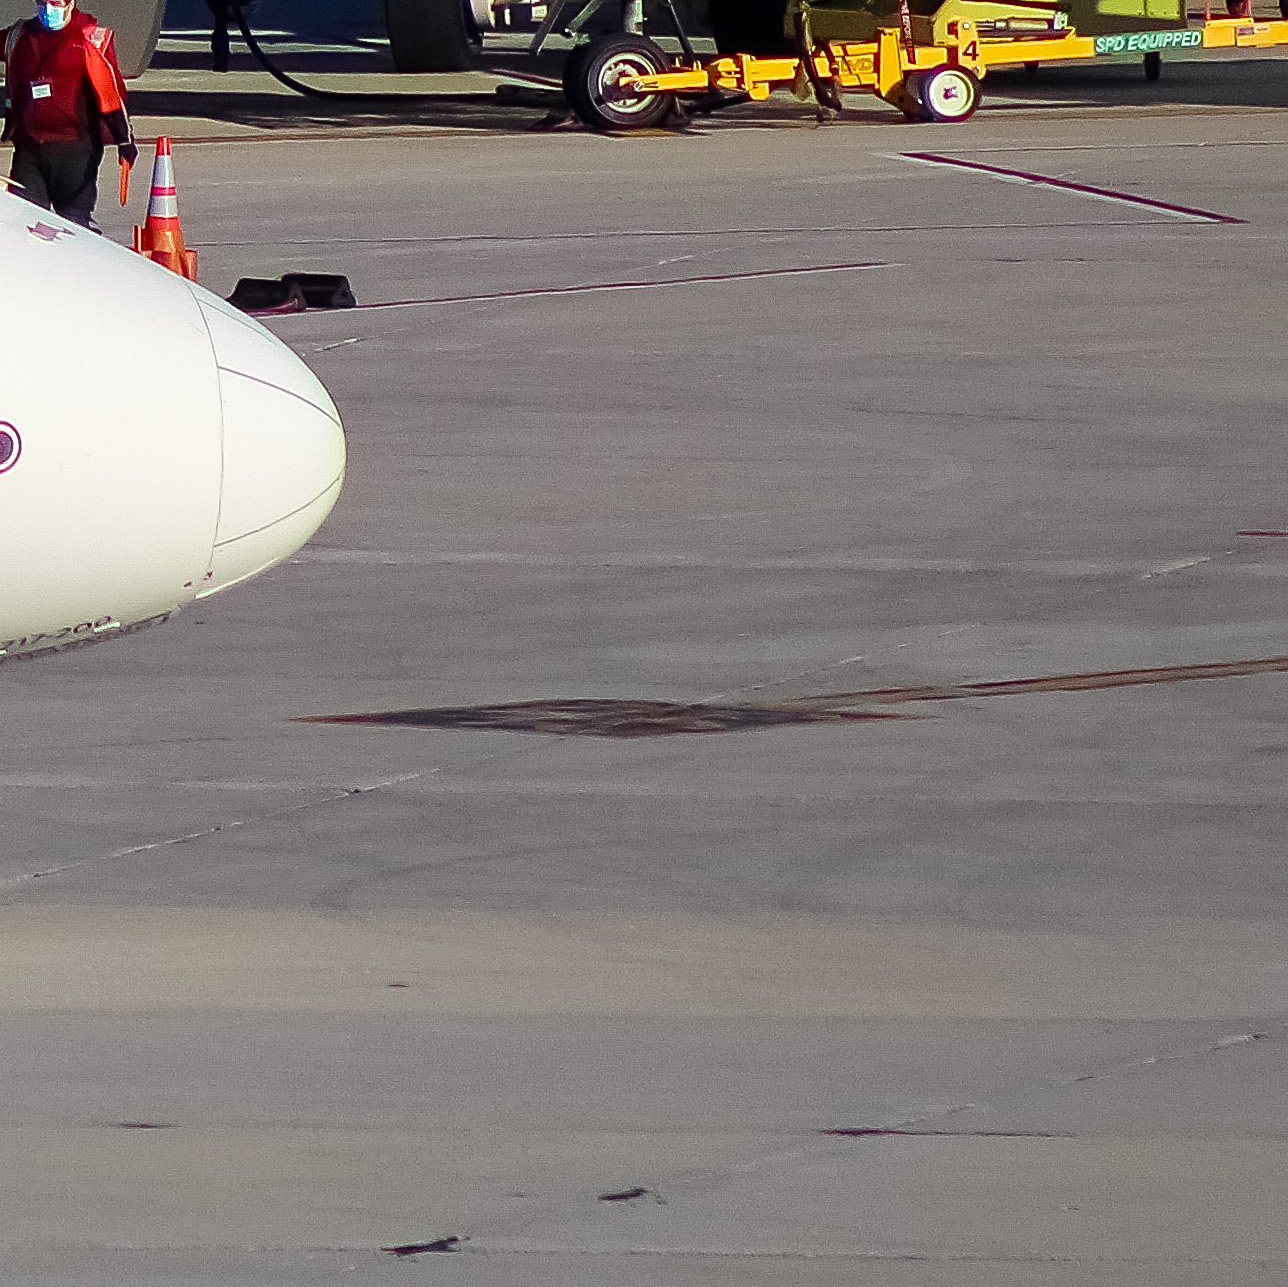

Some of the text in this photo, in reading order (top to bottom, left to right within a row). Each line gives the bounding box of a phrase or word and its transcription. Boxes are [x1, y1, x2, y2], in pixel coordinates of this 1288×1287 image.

[961, 40, 979, 62] 4
[1095, 29, 1202, 53] SPD EQUIPPED
